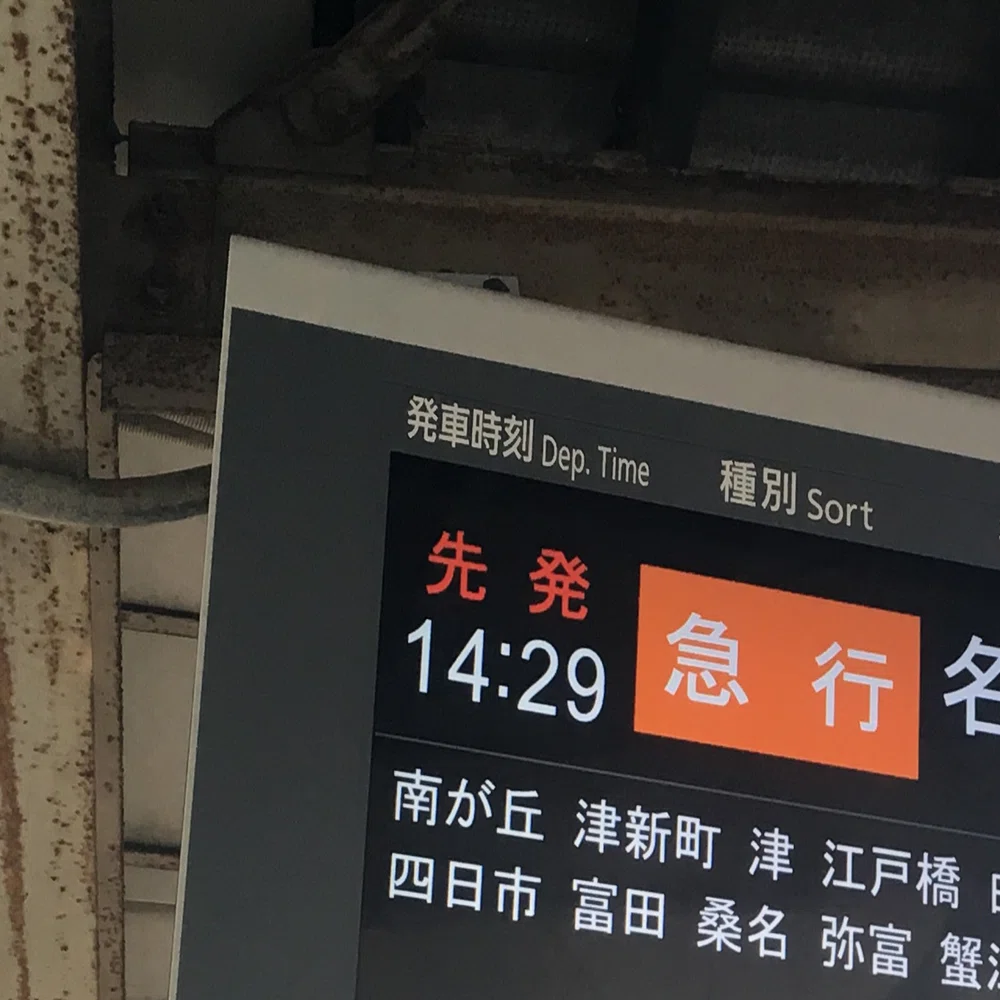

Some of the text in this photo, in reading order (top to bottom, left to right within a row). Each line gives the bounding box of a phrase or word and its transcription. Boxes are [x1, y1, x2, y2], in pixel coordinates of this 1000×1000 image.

[406, 395, 534, 463] 発車時刻
[541, 433, 650, 488] Dep. Time
[720, 458, 798, 516] 種別
[807, 488, 874, 531] Sort
[426, 530, 591, 621] 先発
[406, 617, 606, 724] 14:29
[664, 612, 894, 733] 急行
[392, 767, 545, 842] 南が丘
[572, 798, 722, 870] 津新町
[748, 826, 795, 882] 津
[821, 838, 961, 910] 江戸橋
[388, 851, 542, 922] 四日市
[571, 875, 666, 939] 富田
[696, 895, 788, 961] 桑名
[820, 913, 912, 979] 弥富
